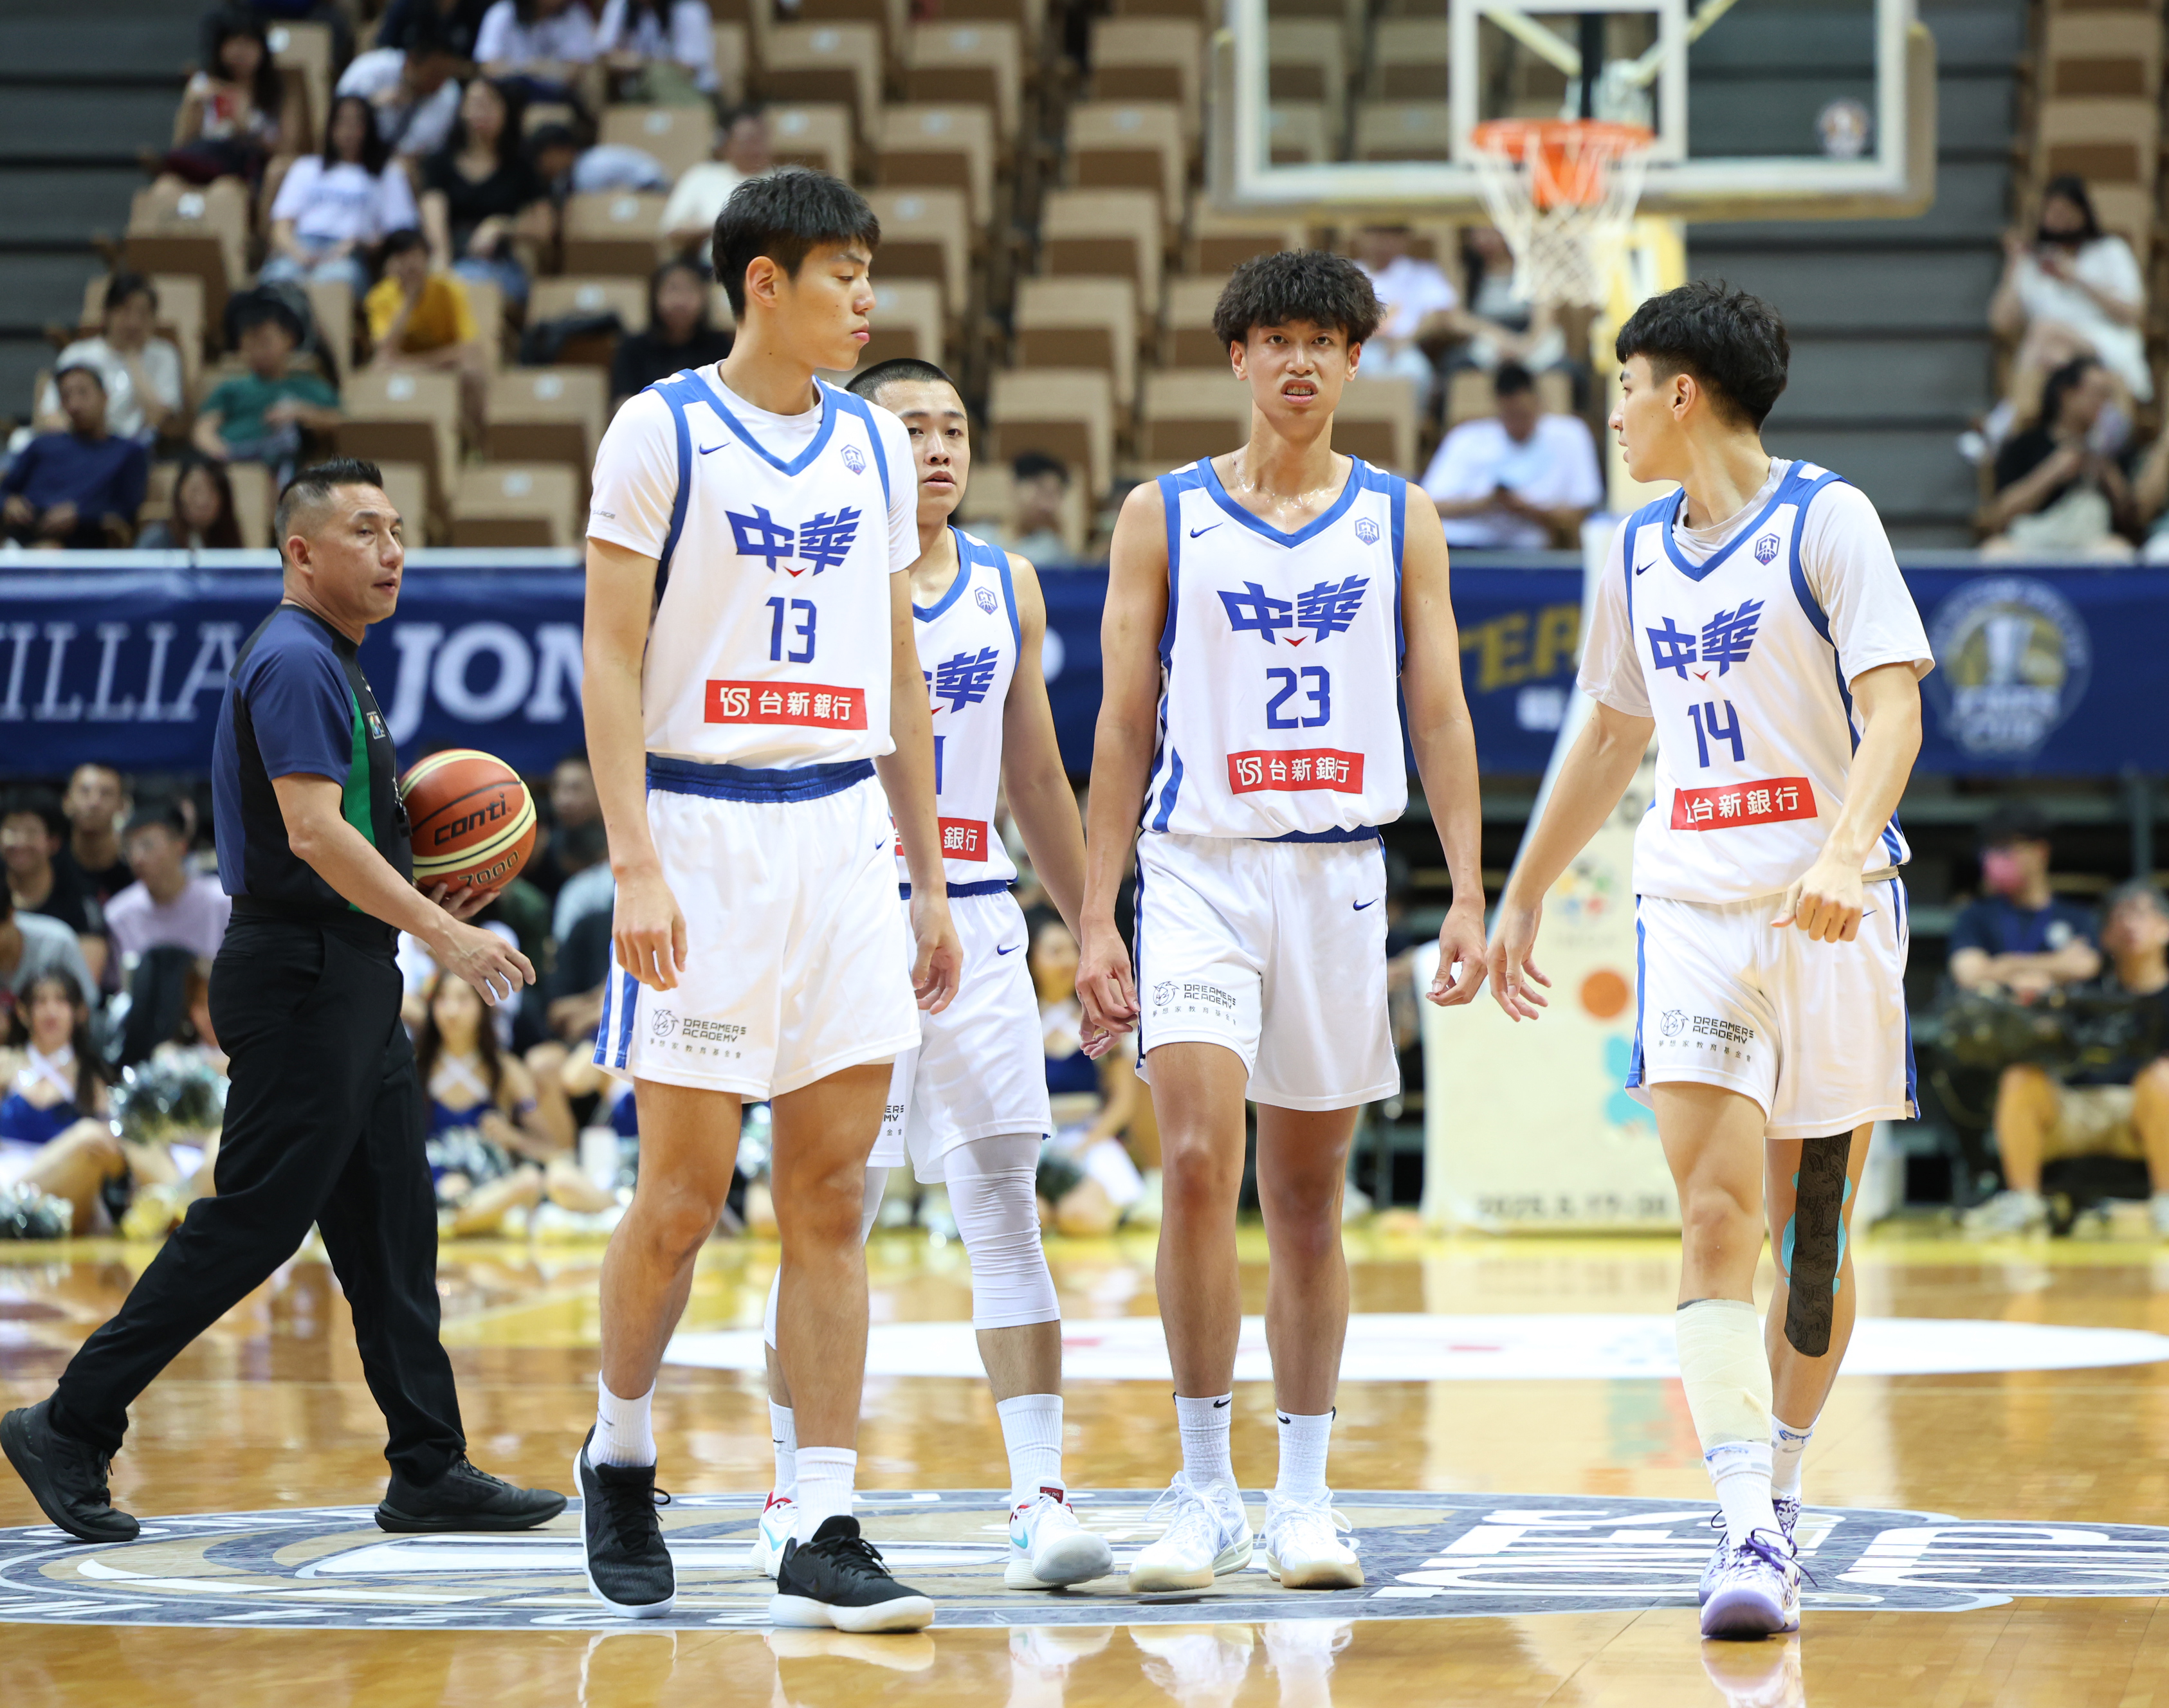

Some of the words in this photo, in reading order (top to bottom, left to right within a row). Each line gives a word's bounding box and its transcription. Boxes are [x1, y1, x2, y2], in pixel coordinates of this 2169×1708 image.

[724, 504, 863, 576] 中華
[1216, 574, 1371, 645] 中華
[765, 596, 817, 664] 13
[1645, 598, 1766, 681] 中華
[922, 646, 1000, 714] 華
[1266, 666, 1330, 729] 23
[758, 689, 852, 721] 台新銀行
[1687, 700, 1745, 768] 14
[1268, 757, 1350, 784] 台新銀行
[1690, 785, 1799, 822] 台新銀行
[457, 849, 520, 886] 7000
[1184, 984, 1236, 1006] DREAMERS
[1184, 992, 1232, 1010] ACADEMY
[682, 1028, 738, 1043] ACADEMY
[683, 1018, 747, 1035] DREAMERS
[1692, 1025, 1748, 1045] ACADEMY
[1693, 1015, 1755, 1039] DREAMERS
